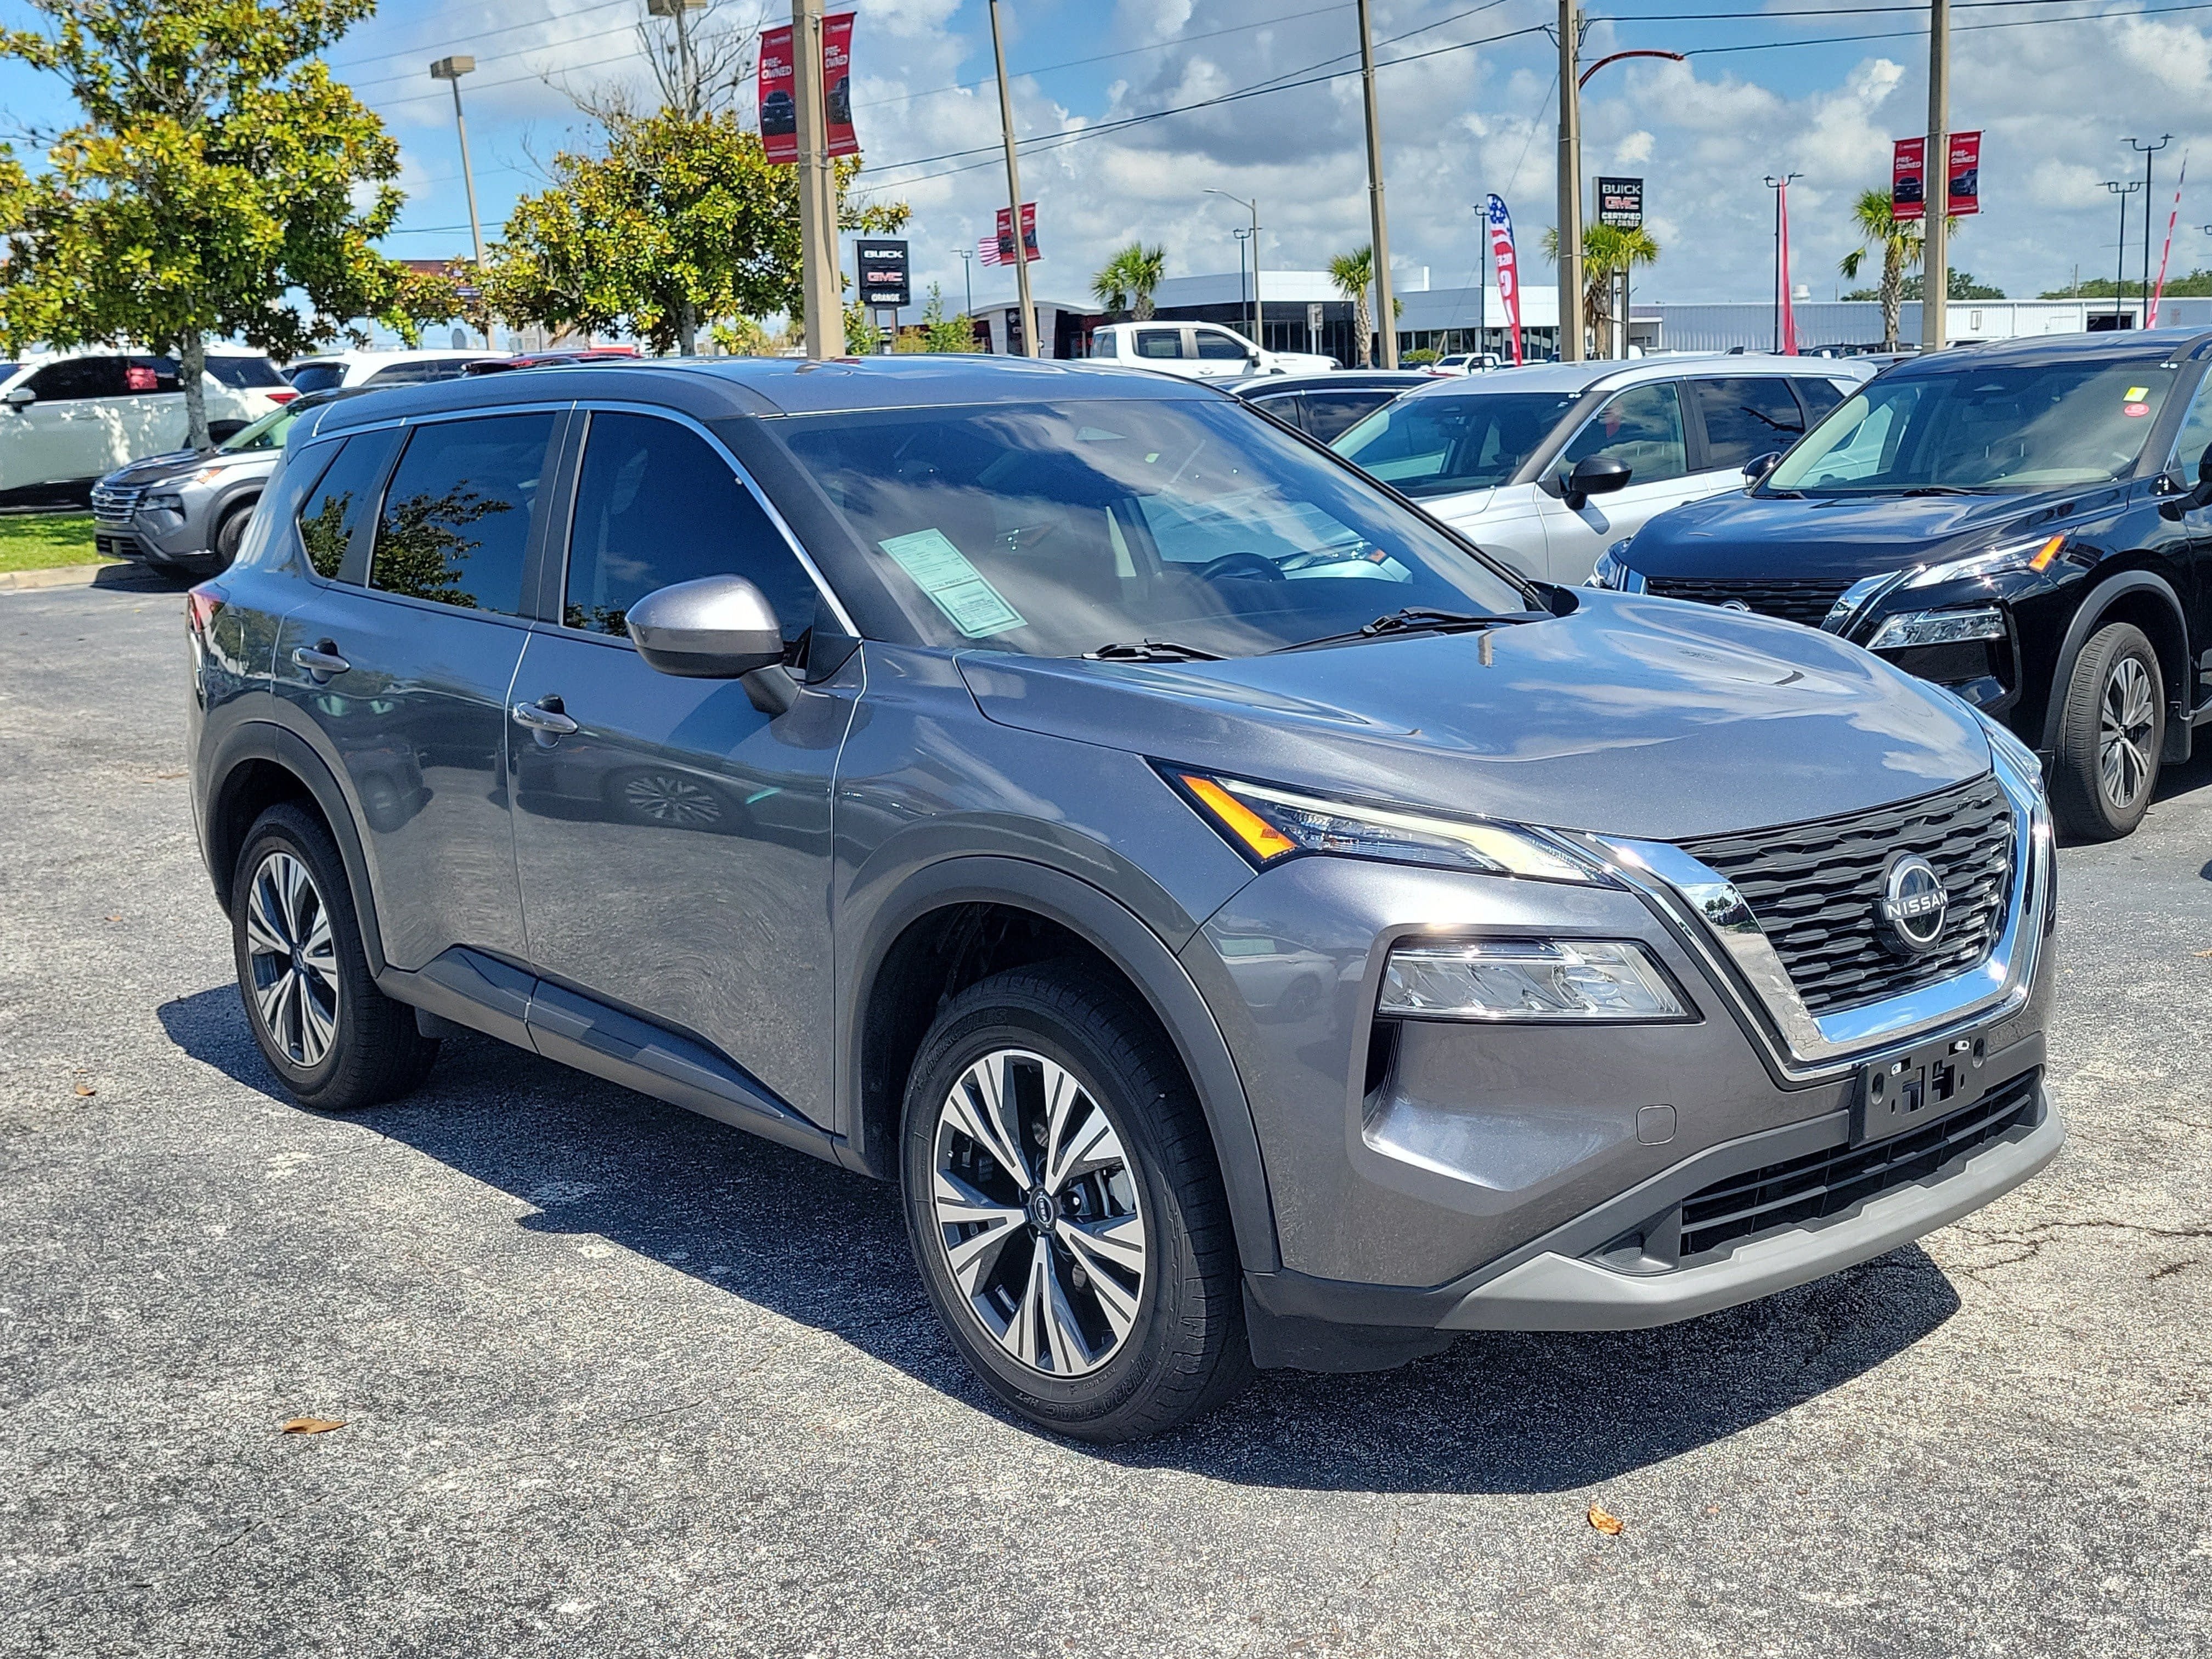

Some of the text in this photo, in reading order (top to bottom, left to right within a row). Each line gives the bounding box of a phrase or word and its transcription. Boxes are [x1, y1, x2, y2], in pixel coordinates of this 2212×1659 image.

[1602, 184, 1641, 194] BUICK
[1605, 196, 1639, 209] GMC
[864, 250, 904, 258] BUICK
[867, 272, 903, 281] GMC
[1887, 888, 1948, 918] NISSAN
[1101, 1351, 1153, 1413] TERRA
[1015, 1392, 1040, 1408] HPT
[1045, 1402, 1098, 1419] TRAC
